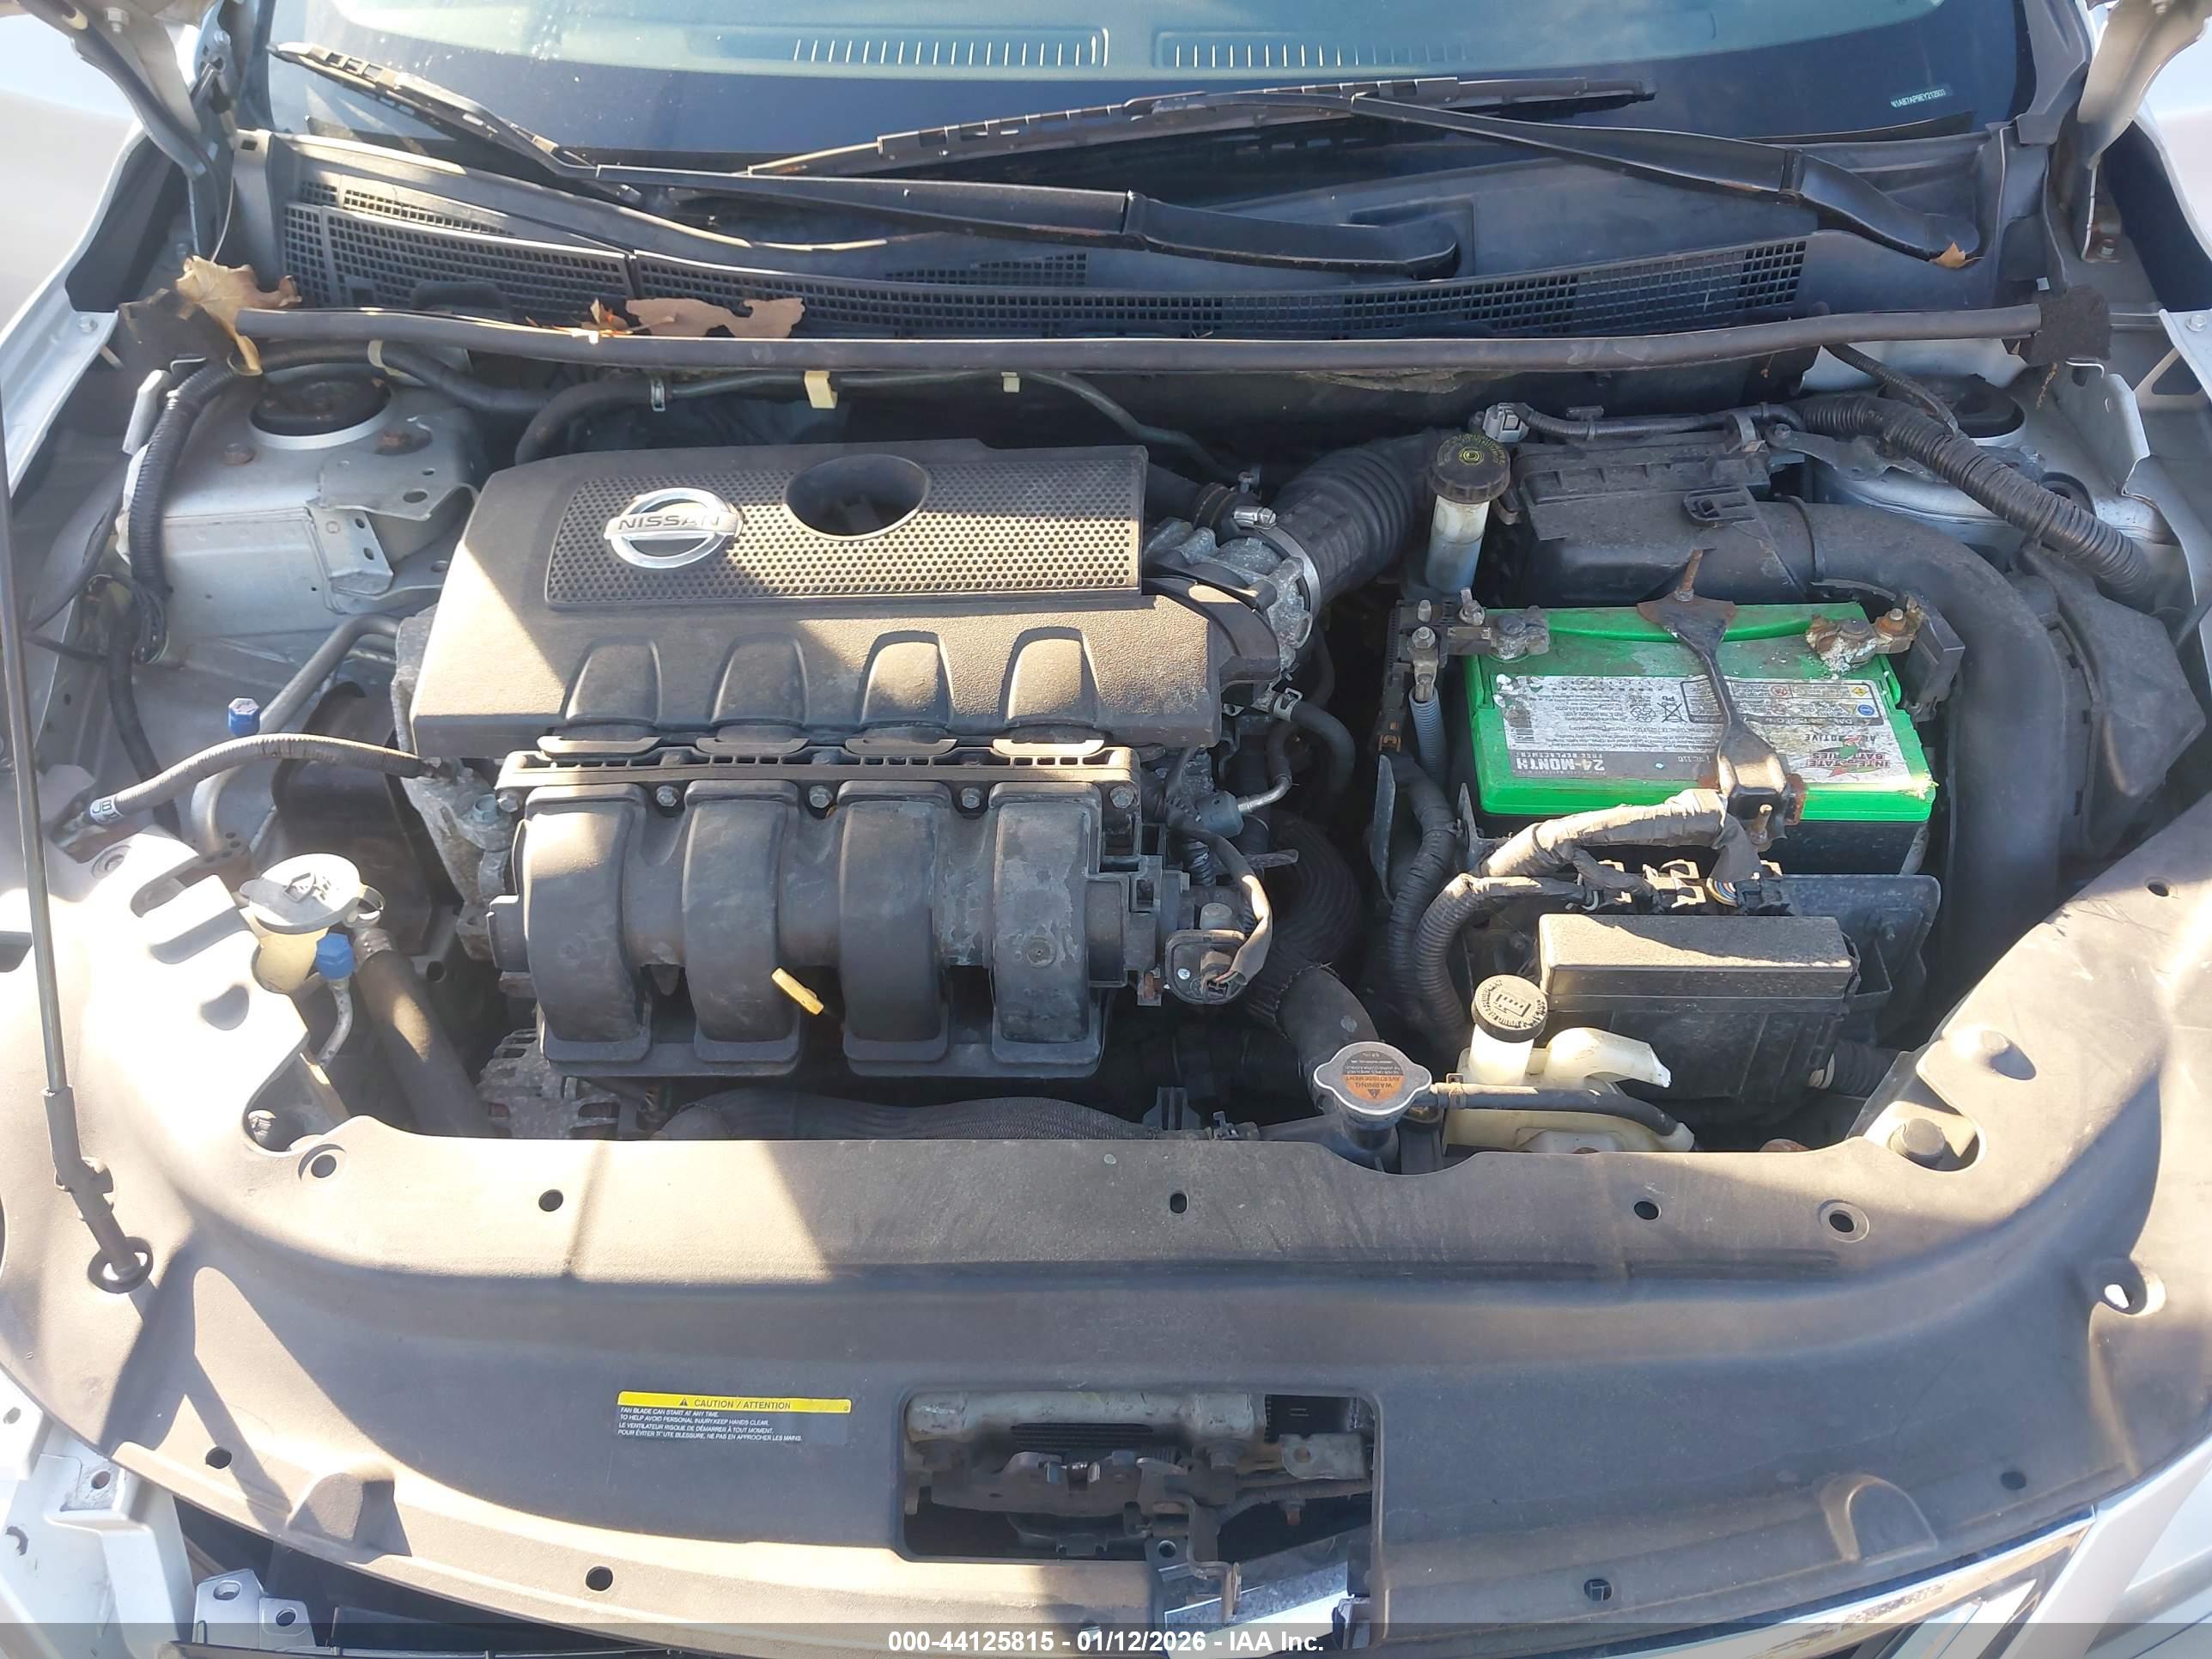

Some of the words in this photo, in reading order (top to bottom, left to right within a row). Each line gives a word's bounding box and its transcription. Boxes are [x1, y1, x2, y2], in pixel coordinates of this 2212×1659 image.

[617, 515, 720, 531] NISSAN
[1516, 757, 1606, 771] 24-MONTH
[92, 799, 112, 814] JB
[694, 1400, 734, 1408] CAUTION
[743, 1401, 791, 1409] ATTENTION
[696, 1425, 727, 1433] DÉMARRER
